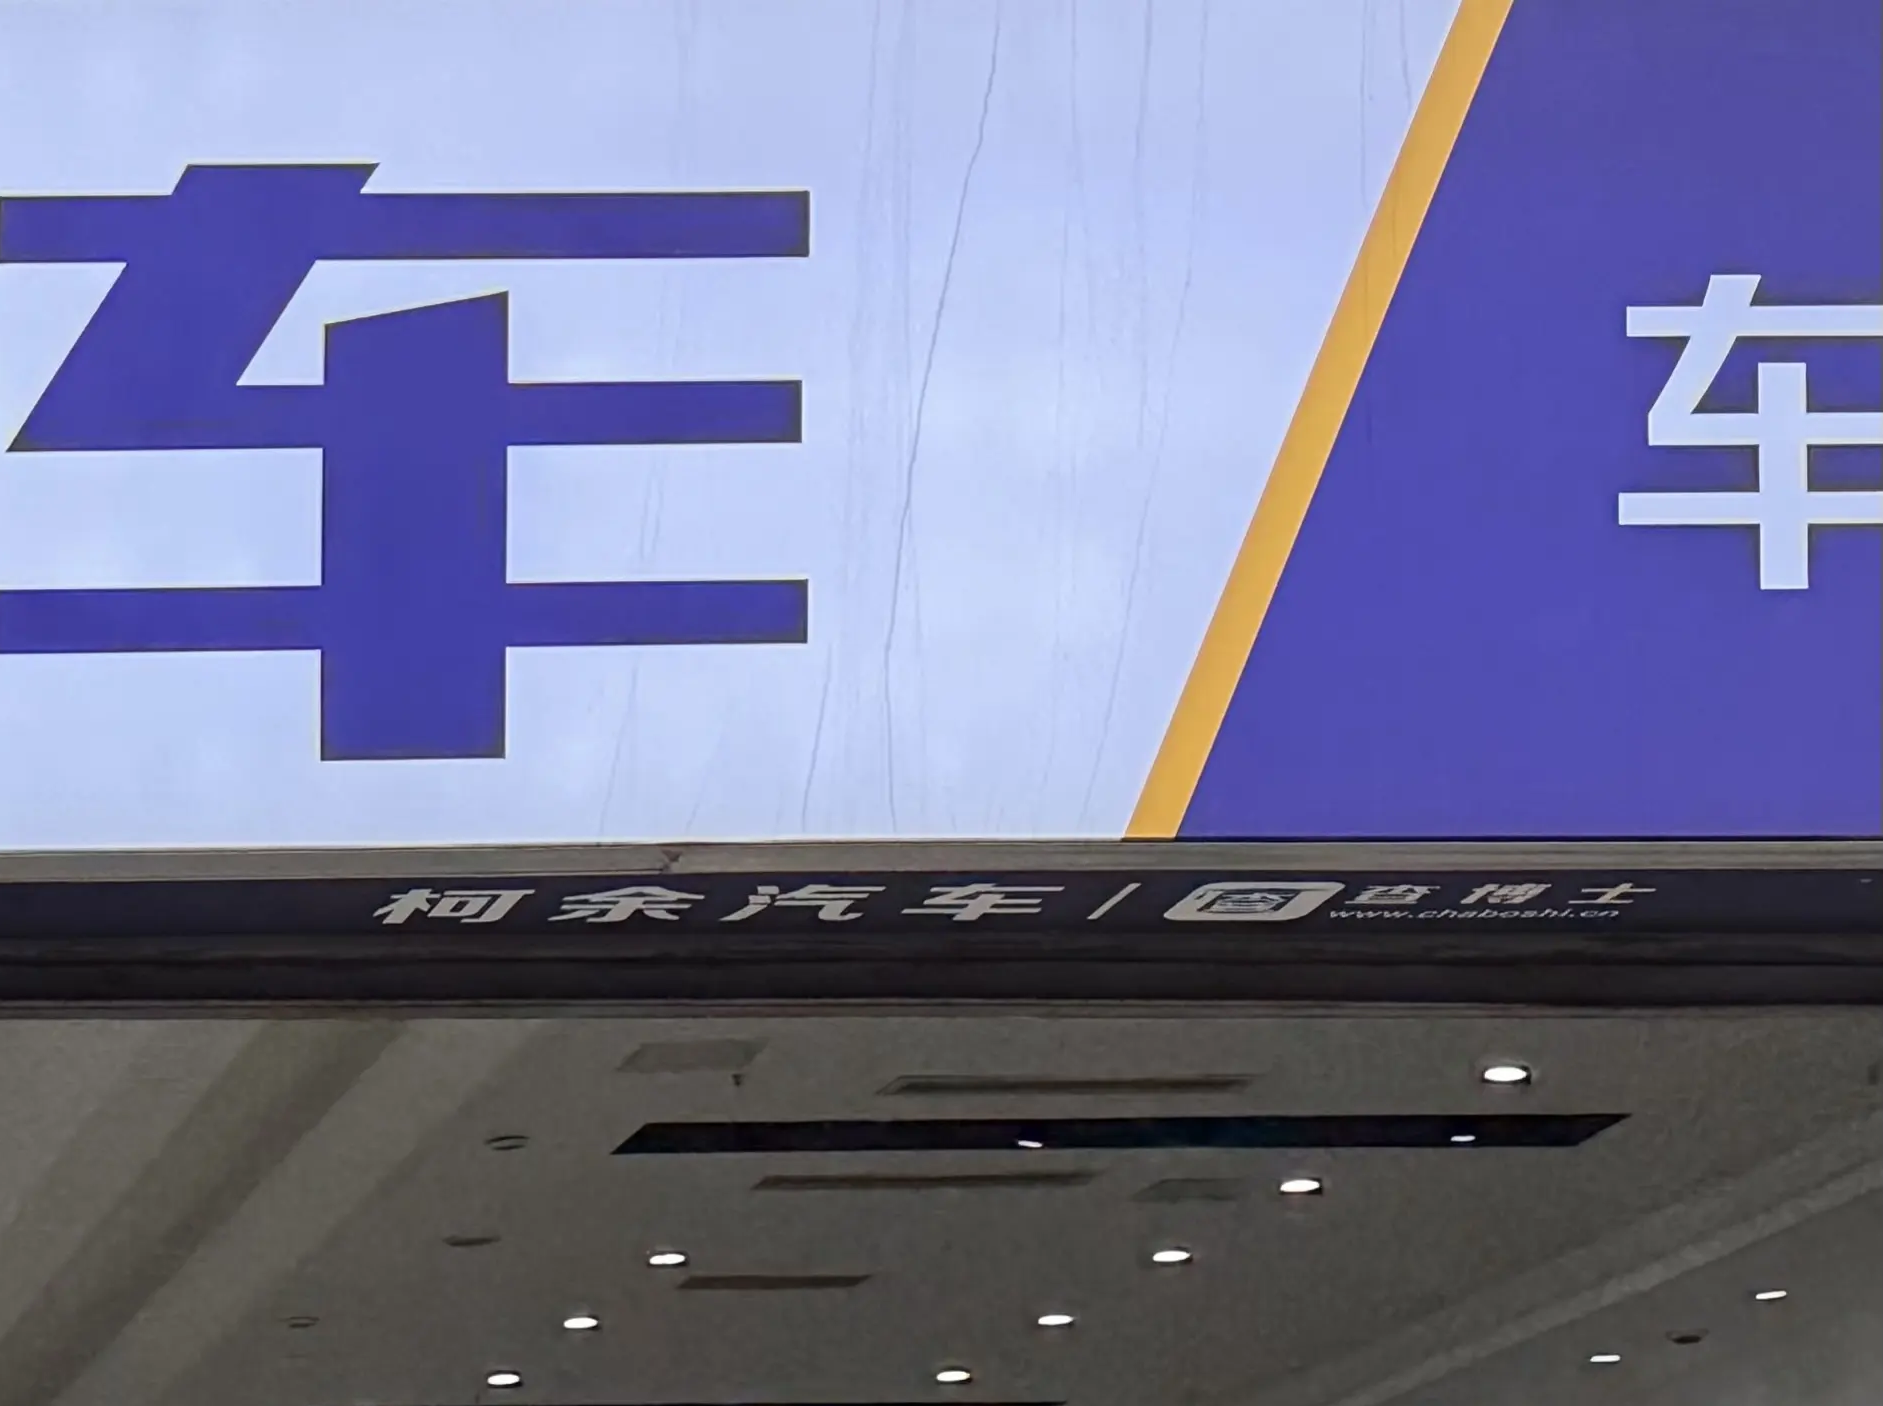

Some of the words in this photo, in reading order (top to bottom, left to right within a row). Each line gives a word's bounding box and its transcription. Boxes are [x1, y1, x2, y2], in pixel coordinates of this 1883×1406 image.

[1619, 274, 1883, 590] 车
[372, 883, 1066, 925] 柯余汽车
